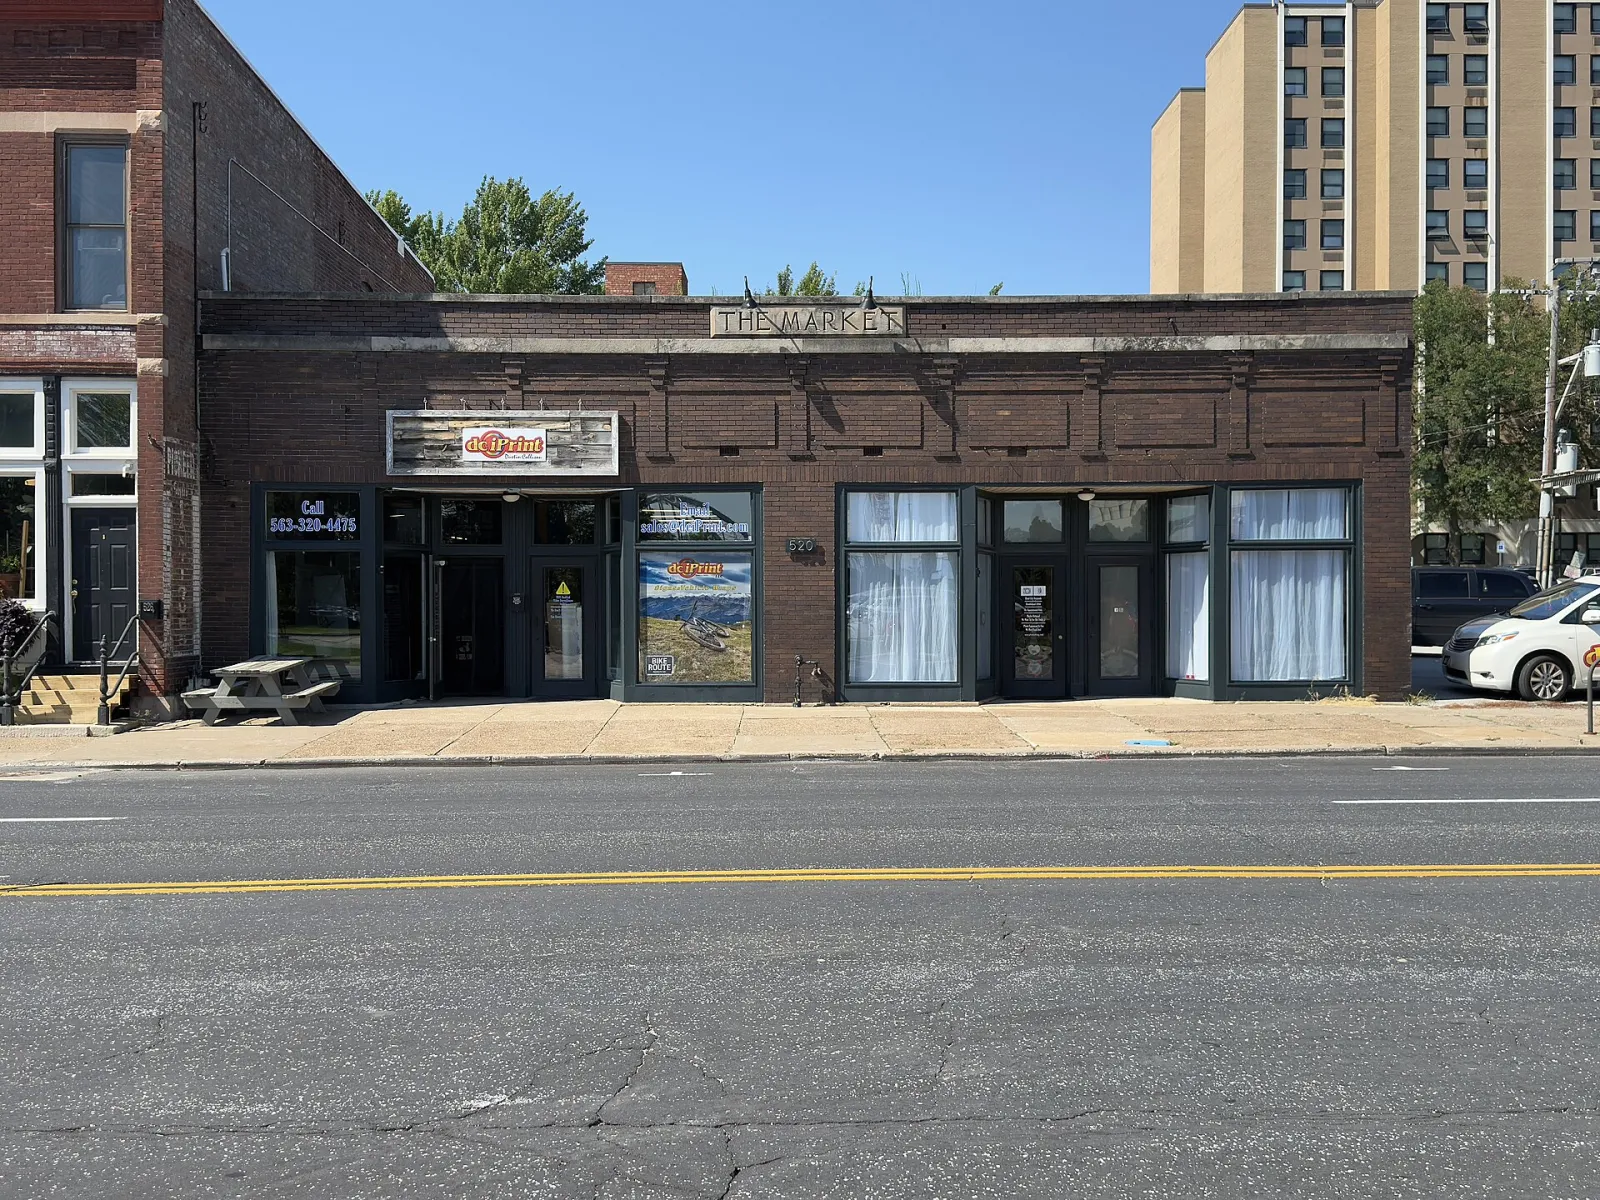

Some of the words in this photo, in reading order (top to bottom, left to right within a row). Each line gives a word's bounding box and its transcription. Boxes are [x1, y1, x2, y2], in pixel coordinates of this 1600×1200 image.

[718, 311, 771, 331] THE
[782, 311, 898, 331] MARKET
[301, 500, 324, 514] Call
[680, 502, 710, 516] Email
[270, 518, 356, 532] 563-320-4475
[790, 540, 813, 551] 520
